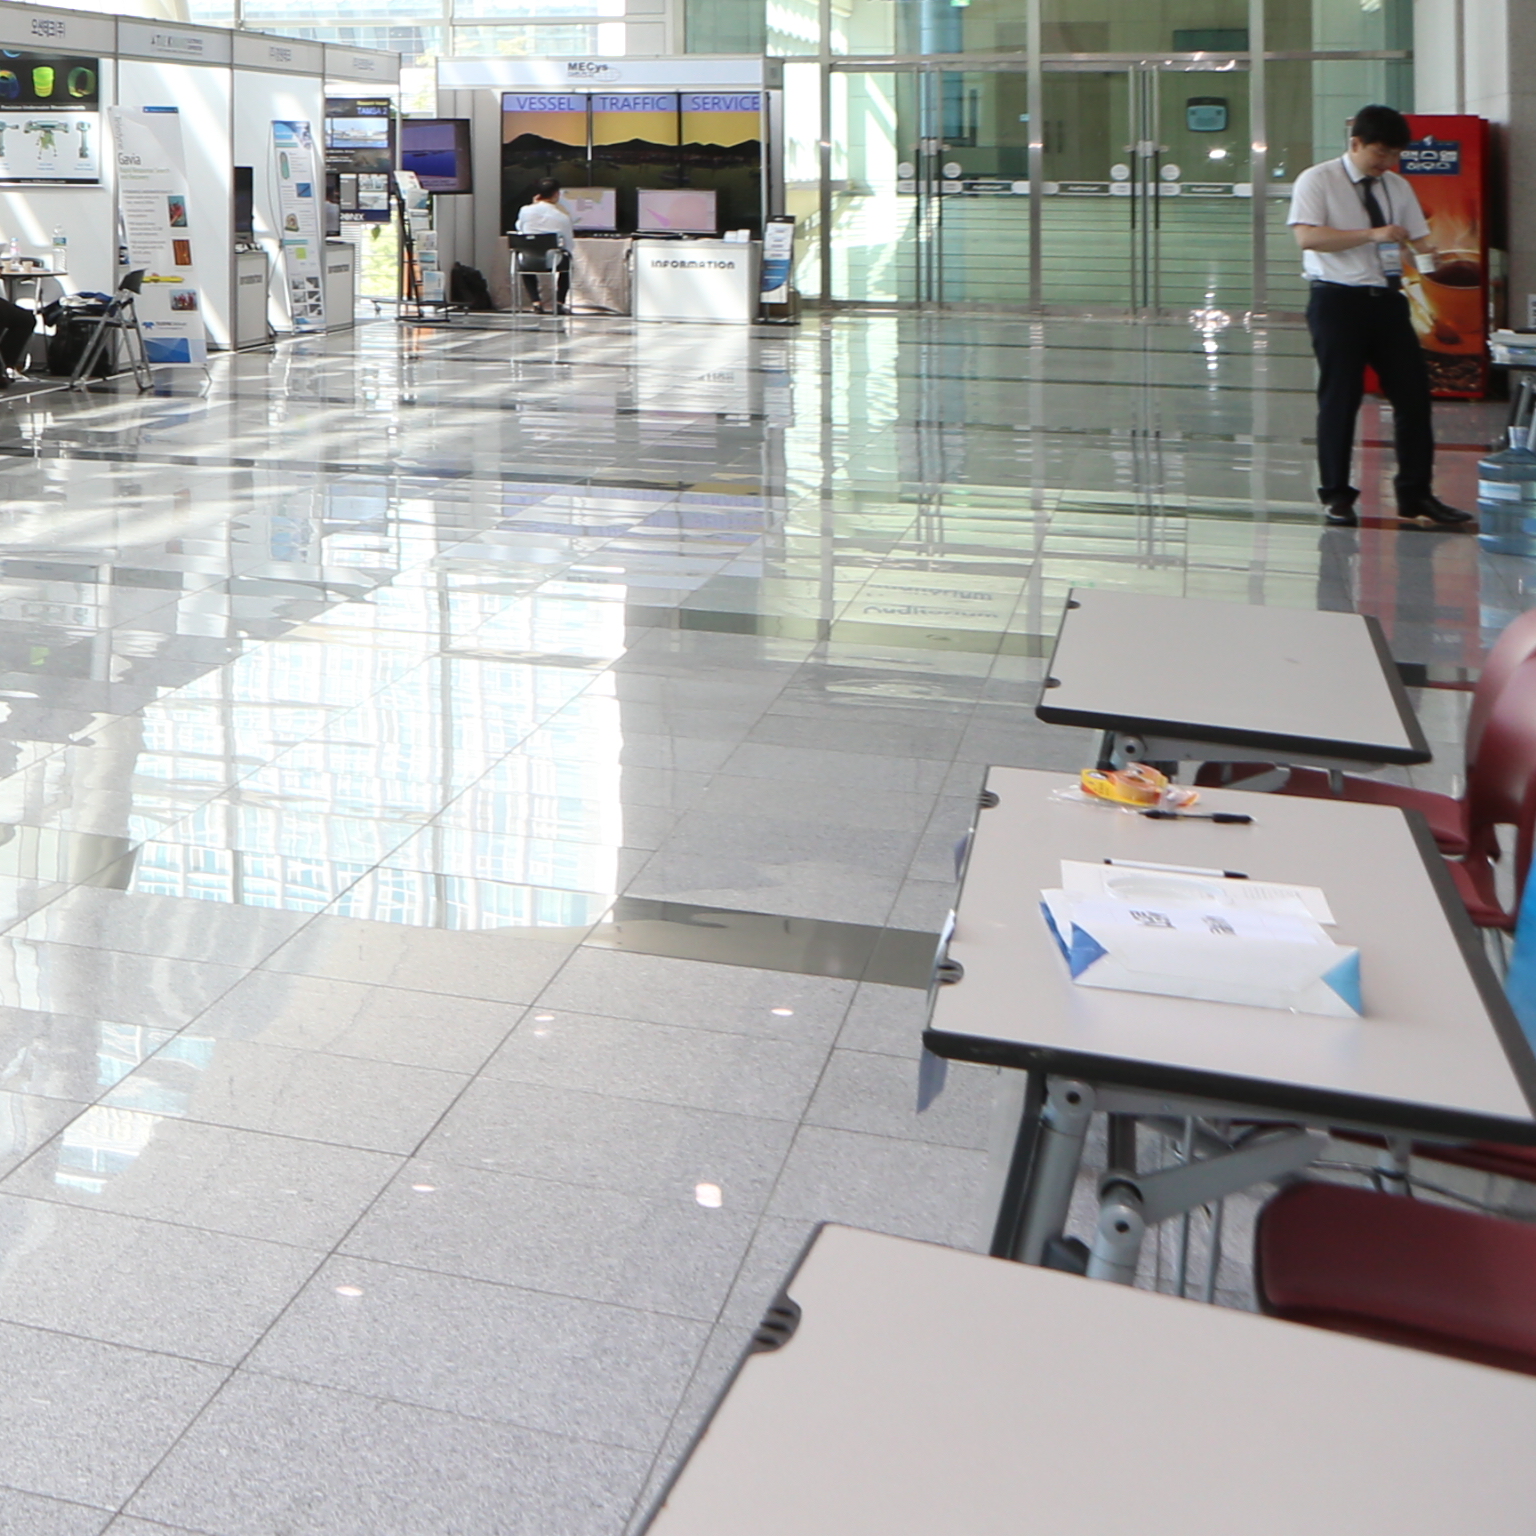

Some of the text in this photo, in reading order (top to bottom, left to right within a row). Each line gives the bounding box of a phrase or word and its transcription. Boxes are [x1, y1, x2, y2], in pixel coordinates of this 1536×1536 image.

[516, 96, 760, 112] VESSEL TRAFFIC SERVICE
[117, 152, 142, 165] Gavia
[651, 259, 735, 270] INFORMATION
